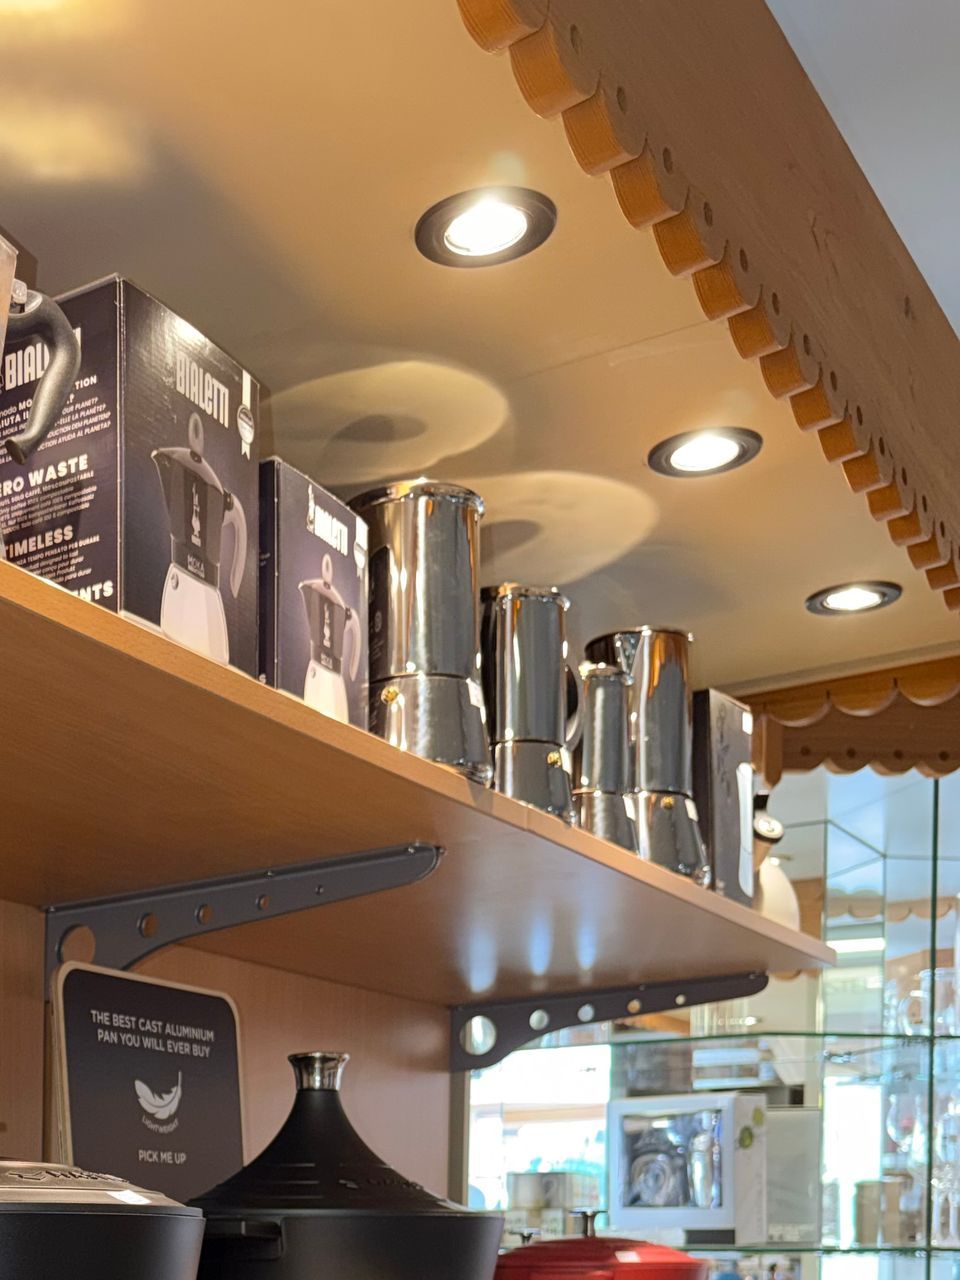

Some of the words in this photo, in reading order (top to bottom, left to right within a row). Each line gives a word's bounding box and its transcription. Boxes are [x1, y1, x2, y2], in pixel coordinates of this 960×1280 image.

[28, 454, 89, 487] WASTE
[91, 1010, 111, 1025] THE
[113, 1013, 136, 1029] BEST
[139, 1018, 162, 1033] CAST
[165, 1023, 214, 1042] ALUMINIUM
[98, 1029, 118, 1044] PAN
[120, 1032, 140, 1048] YOU
[142, 1036, 165, 1051] WILL
[167, 1040, 190, 1055] EVER
[192, 1045, 210, 1058] BUY
[142, 1115, 179, 1134] LIGHTWEIGHT
[139, 1150, 158, 1163] PICK
[160, 1151, 173, 1163] ME
[175, 1153, 186, 1165] UP
